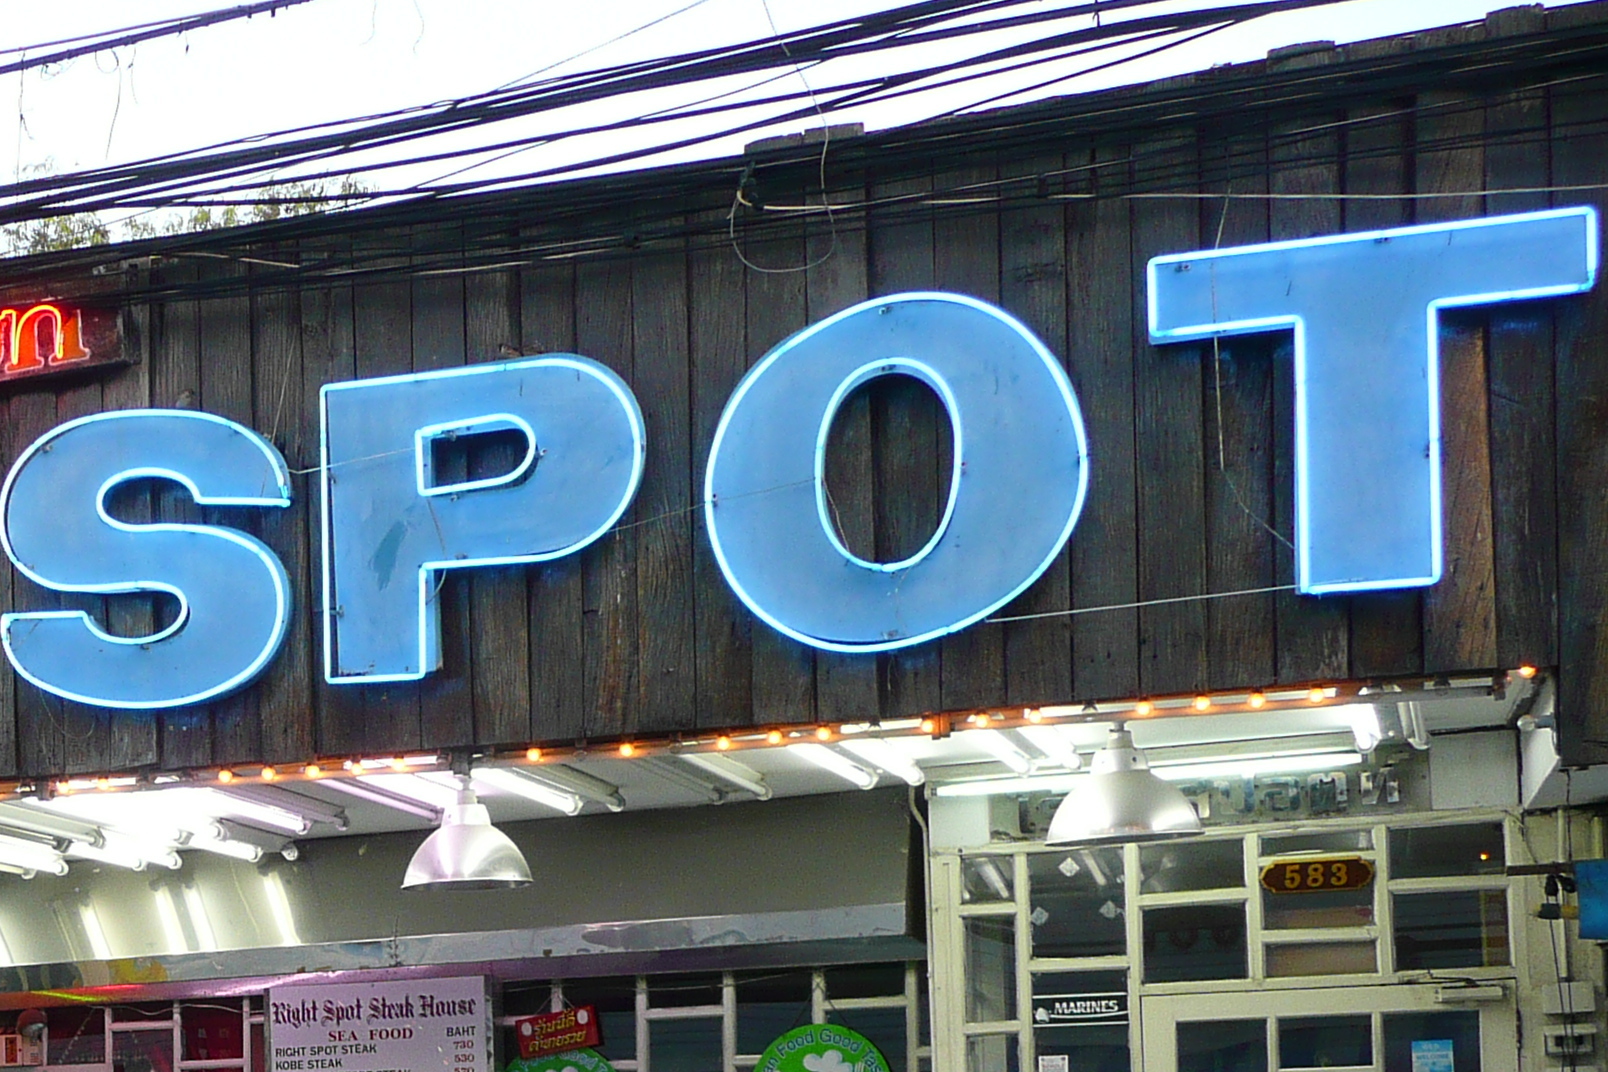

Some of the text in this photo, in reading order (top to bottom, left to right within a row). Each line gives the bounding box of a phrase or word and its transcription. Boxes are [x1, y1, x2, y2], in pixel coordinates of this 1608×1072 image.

[1284, 863, 1348, 889] 583
[271, 994, 476, 1029] Right Spot Steak House
[1054, 1000, 1119, 1014] MARINES
[328, 1028, 413, 1042] SEA FOOD
[446, 1026, 476, 1037] BAHT
[275, 1043, 377, 1057] RIGHT SPOT STEAK
[453, 1040, 474, 1050] 730
[775, 1030, 815, 1058] Food
[819, 1028, 863, 1054] Good
[275, 1058, 342, 1070] KOBE STEAK
